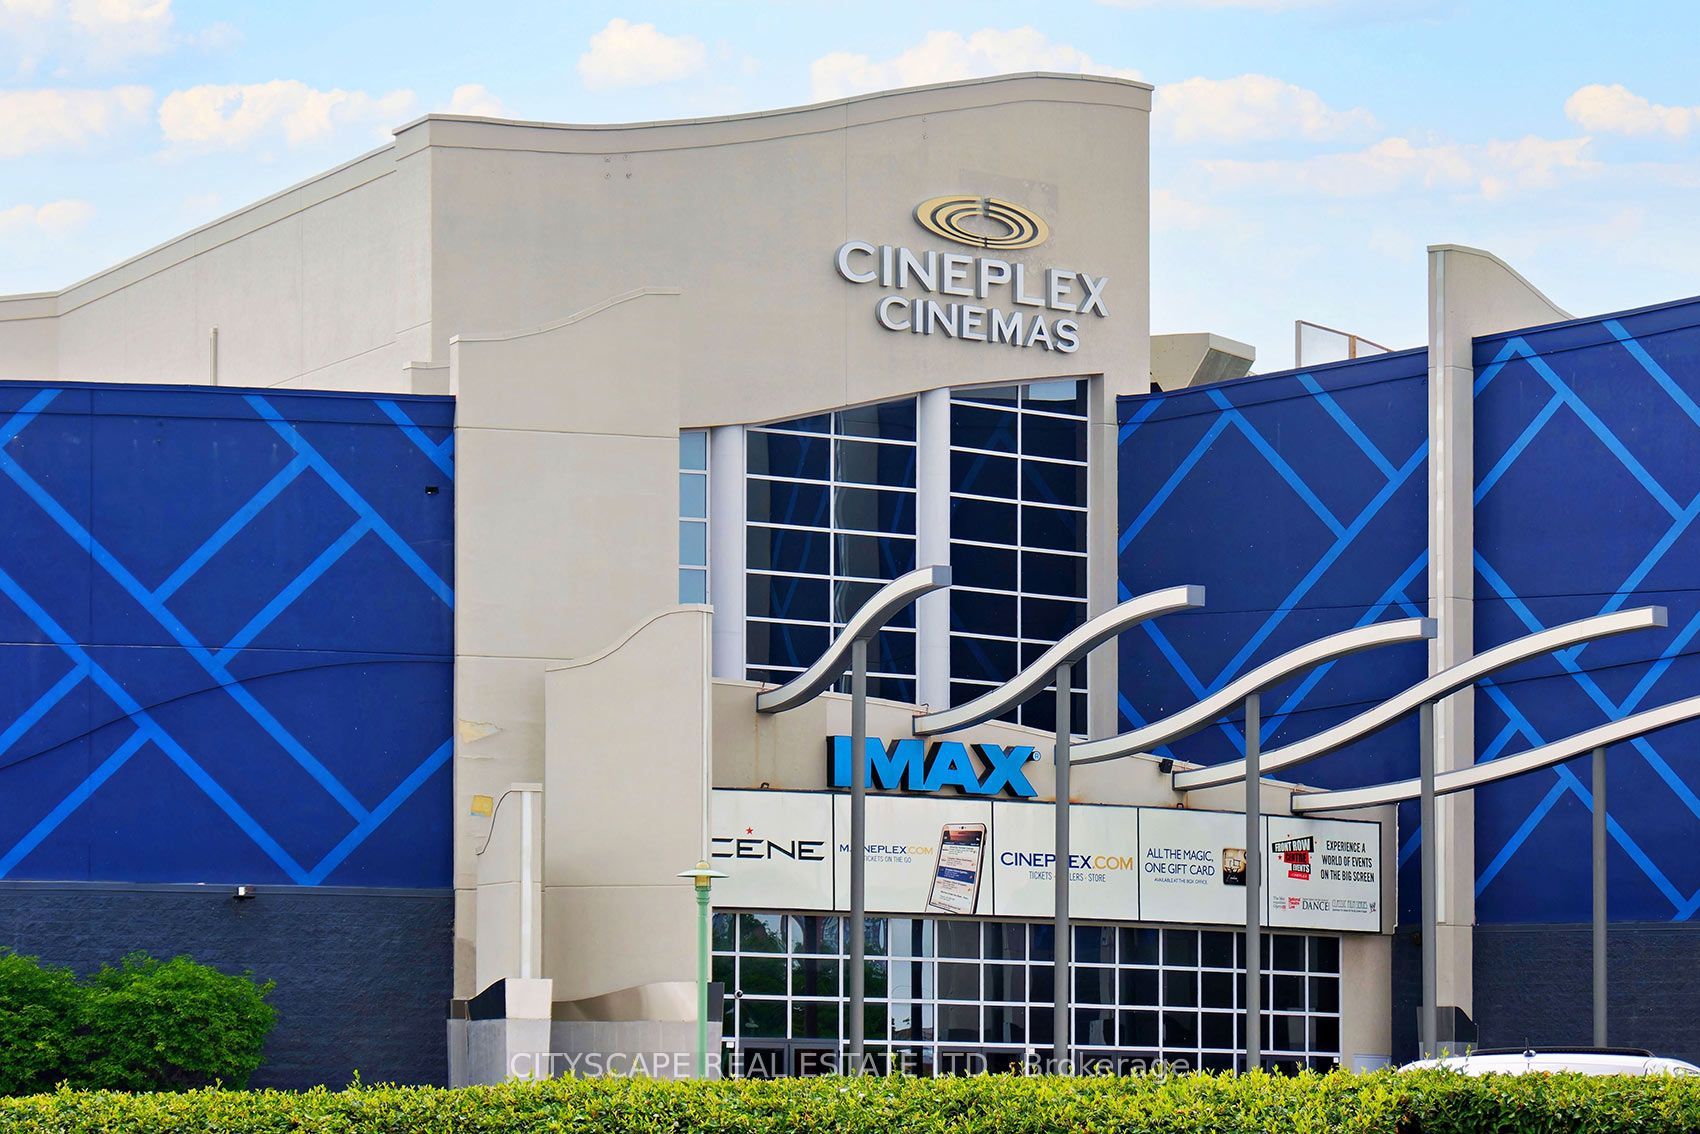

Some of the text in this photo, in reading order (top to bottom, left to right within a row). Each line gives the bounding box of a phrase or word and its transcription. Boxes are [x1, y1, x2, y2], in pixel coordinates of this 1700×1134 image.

[835, 240, 1109, 317] CINEPLEX
[875, 295, 1080, 353] CINEMAS
[826, 735, 1038, 797] IMAX
[711, 837, 825, 861] CENE
[1274, 838, 1310, 852] FRONT ROW
[1326, 840, 1366, 853] EXPERIENCE A
[864, 855, 884, 863] ICKETS
[1000, 852, 1133, 870] CINEPEX.COM
[1146, 848, 1214, 862] ALL THE MAGIC,
[1321, 854, 1372, 868] WORLD OF EVENTS
[1145, 862, 1215, 876] ONE GIFT CARD
[1320, 869, 1375, 882] ON THE BIG SCREEN
[1029, 871, 1053, 880] TICKETS
[1088, 873, 1106, 882] STORE
[1302, 900, 1329, 911] DANCE
